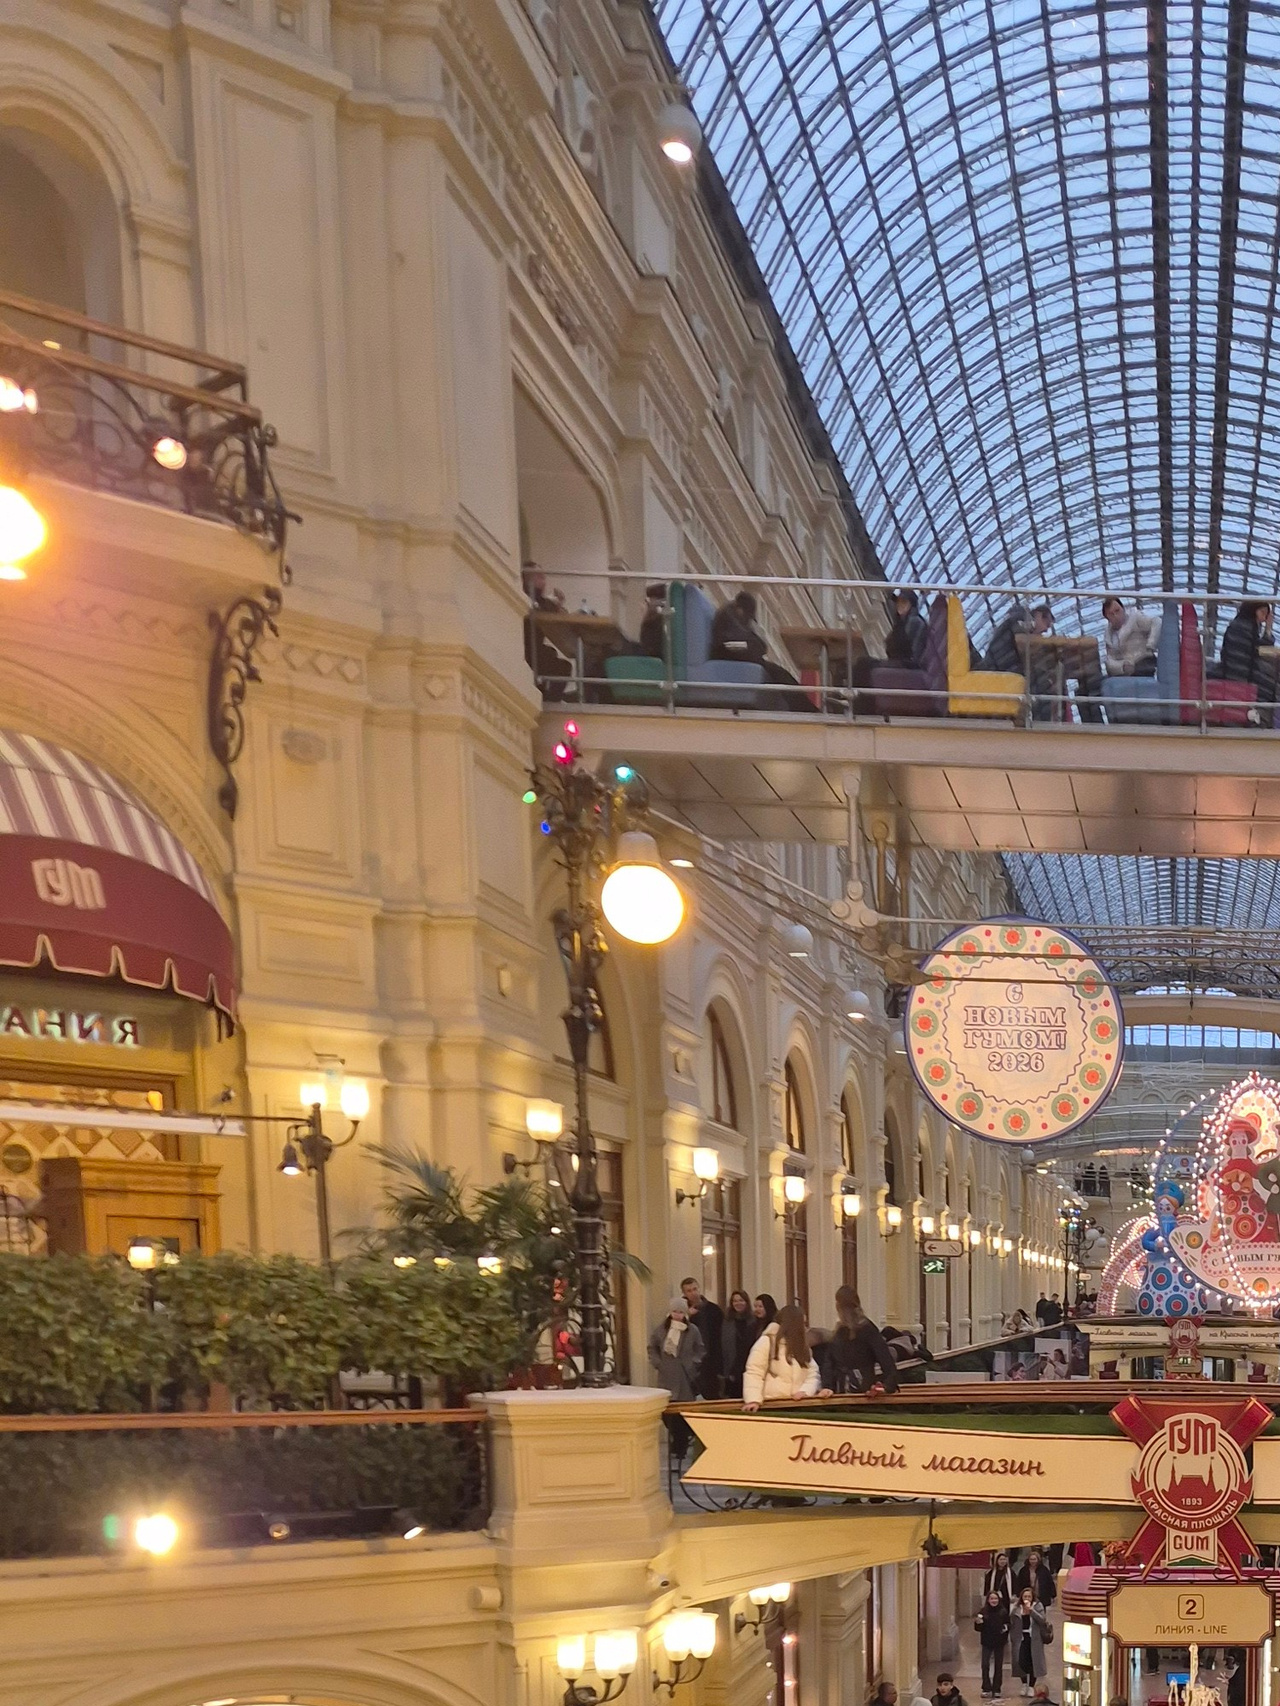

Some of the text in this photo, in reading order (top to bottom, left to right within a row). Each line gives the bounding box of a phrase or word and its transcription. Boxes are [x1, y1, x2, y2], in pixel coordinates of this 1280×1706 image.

[31, 857, 107, 910] ГУМ
[1005, 982, 1024, 1004] С
[963, 1005, 1067, 1027] НОВЫМ
[963, 1028, 1068, 1051] ГУМОМ!
[987, 1051, 1045, 1072] 2026
[1168, 1418, 1216, 1456] ГУМ
[788, 1434, 907, 1469] Главный
[922, 1452, 1045, 1477] магазин
[1181, 1497, 1203, 1506] 1893
[1146, 1497, 1238, 1529] КРАСНАЯ ПЛОЩАДЬ
[1173, 1535, 1210, 1551] GUM
[1185, 1599, 1197, 1615] 2
[1155, 1625, 1228, 1634] ЛИНИЯ LINE
